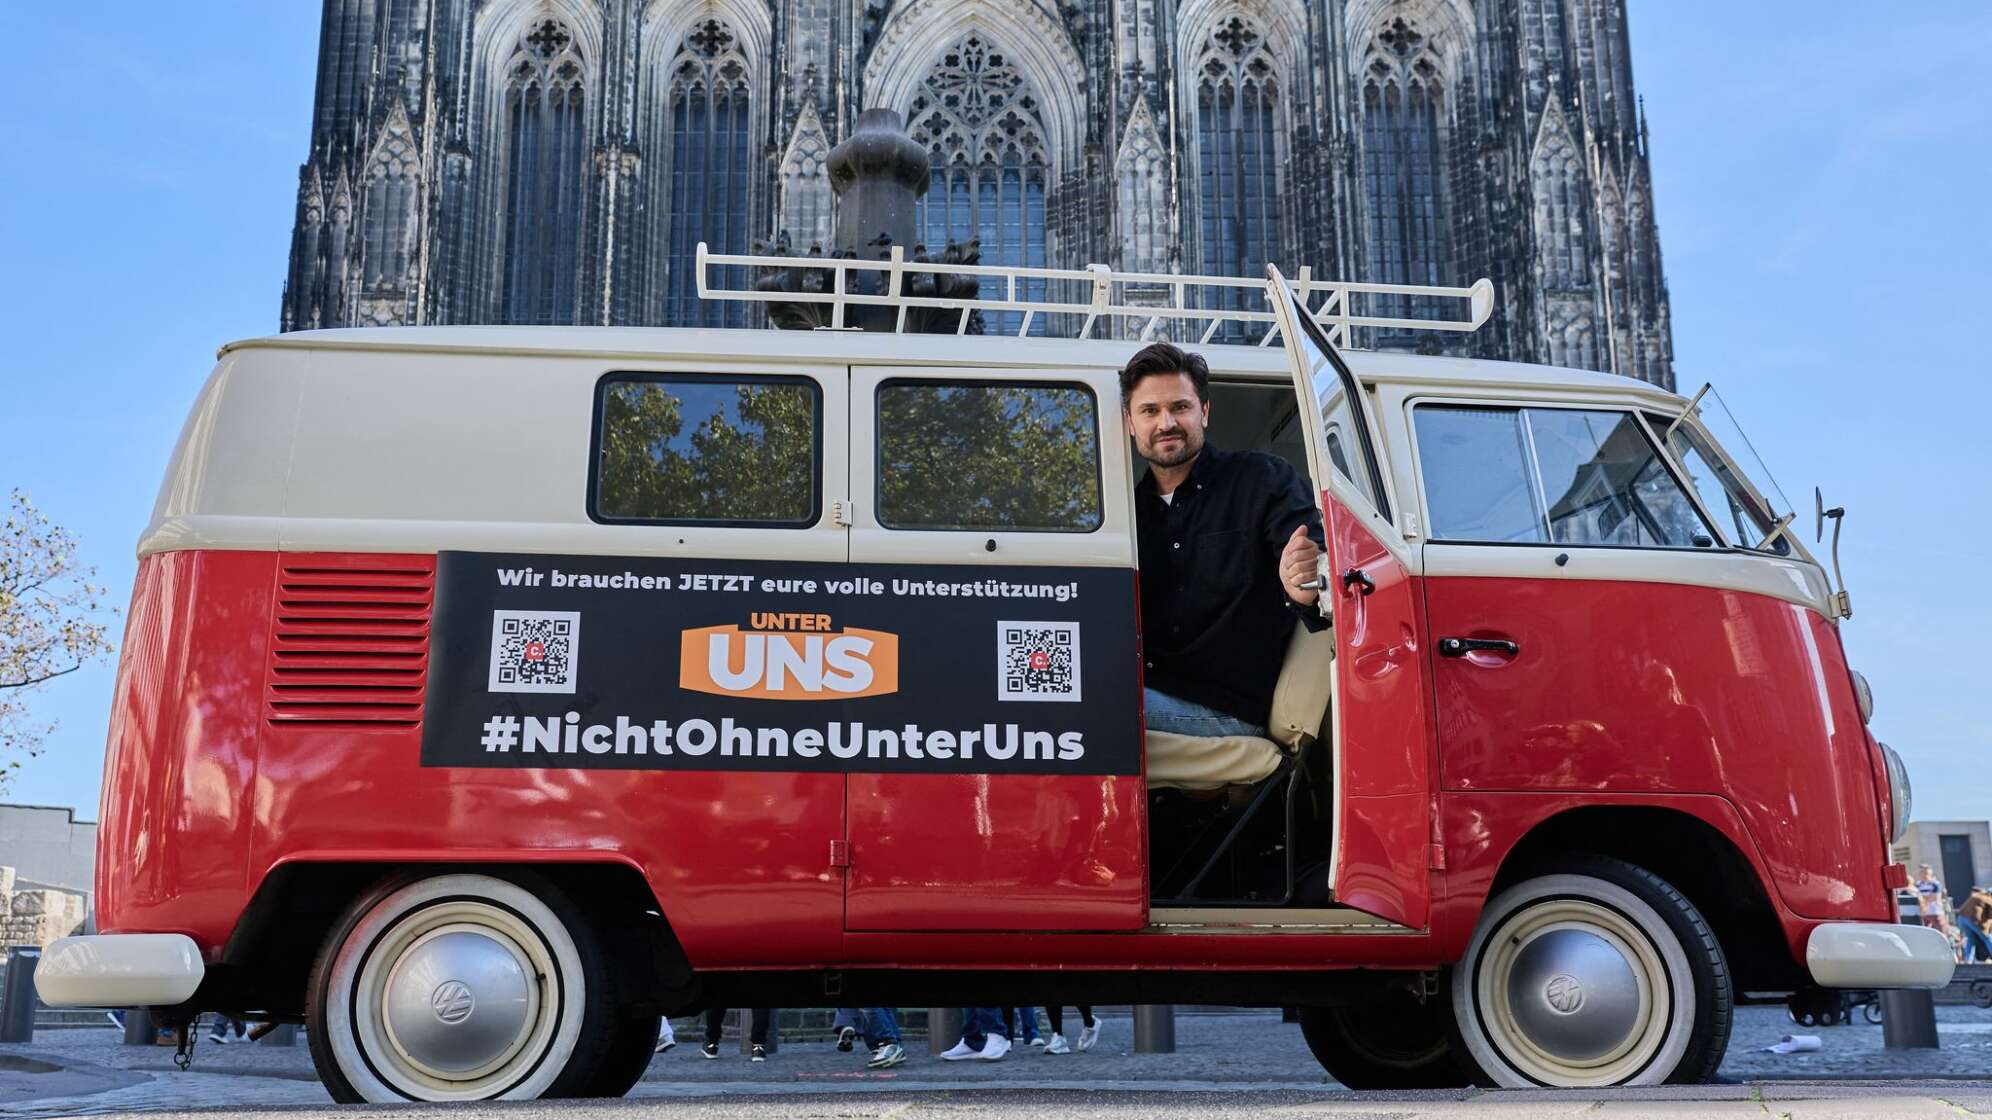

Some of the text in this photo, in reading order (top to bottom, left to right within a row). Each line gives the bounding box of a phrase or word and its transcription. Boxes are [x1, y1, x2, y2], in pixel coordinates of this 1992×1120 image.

[497, 567, 1078, 602] Wir brauchen JETZT eure volle Unterstützung!
[751, 612, 831, 631] UNTER
[708, 633, 875, 693] UNS
[481, 711, 1085, 761] #NichtOhneUnterUns
